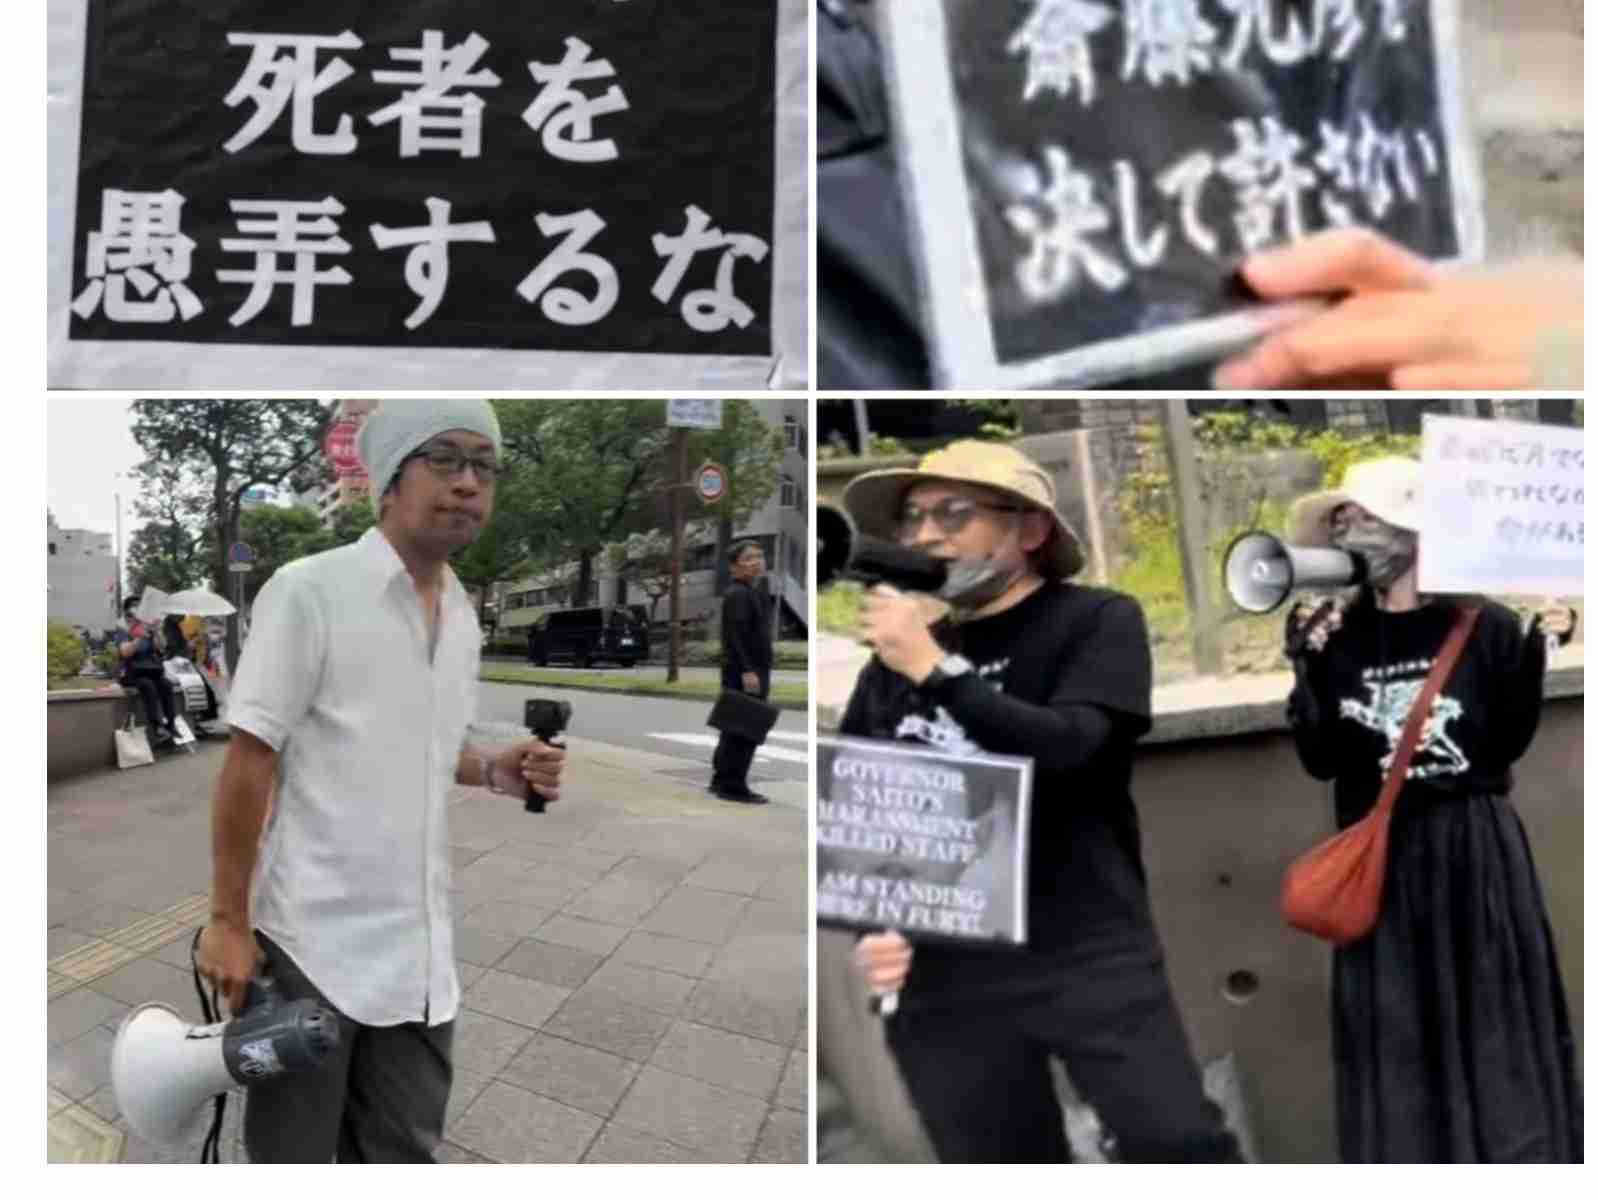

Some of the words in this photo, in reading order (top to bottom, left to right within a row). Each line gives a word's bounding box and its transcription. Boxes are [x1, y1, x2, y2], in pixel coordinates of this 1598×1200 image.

[222, 29, 631, 162] 死者を
[71, 188, 770, 332] 愚弄するな
[832, 756, 966, 794] GOVERNOR
[861, 877, 988, 912] STANDING
